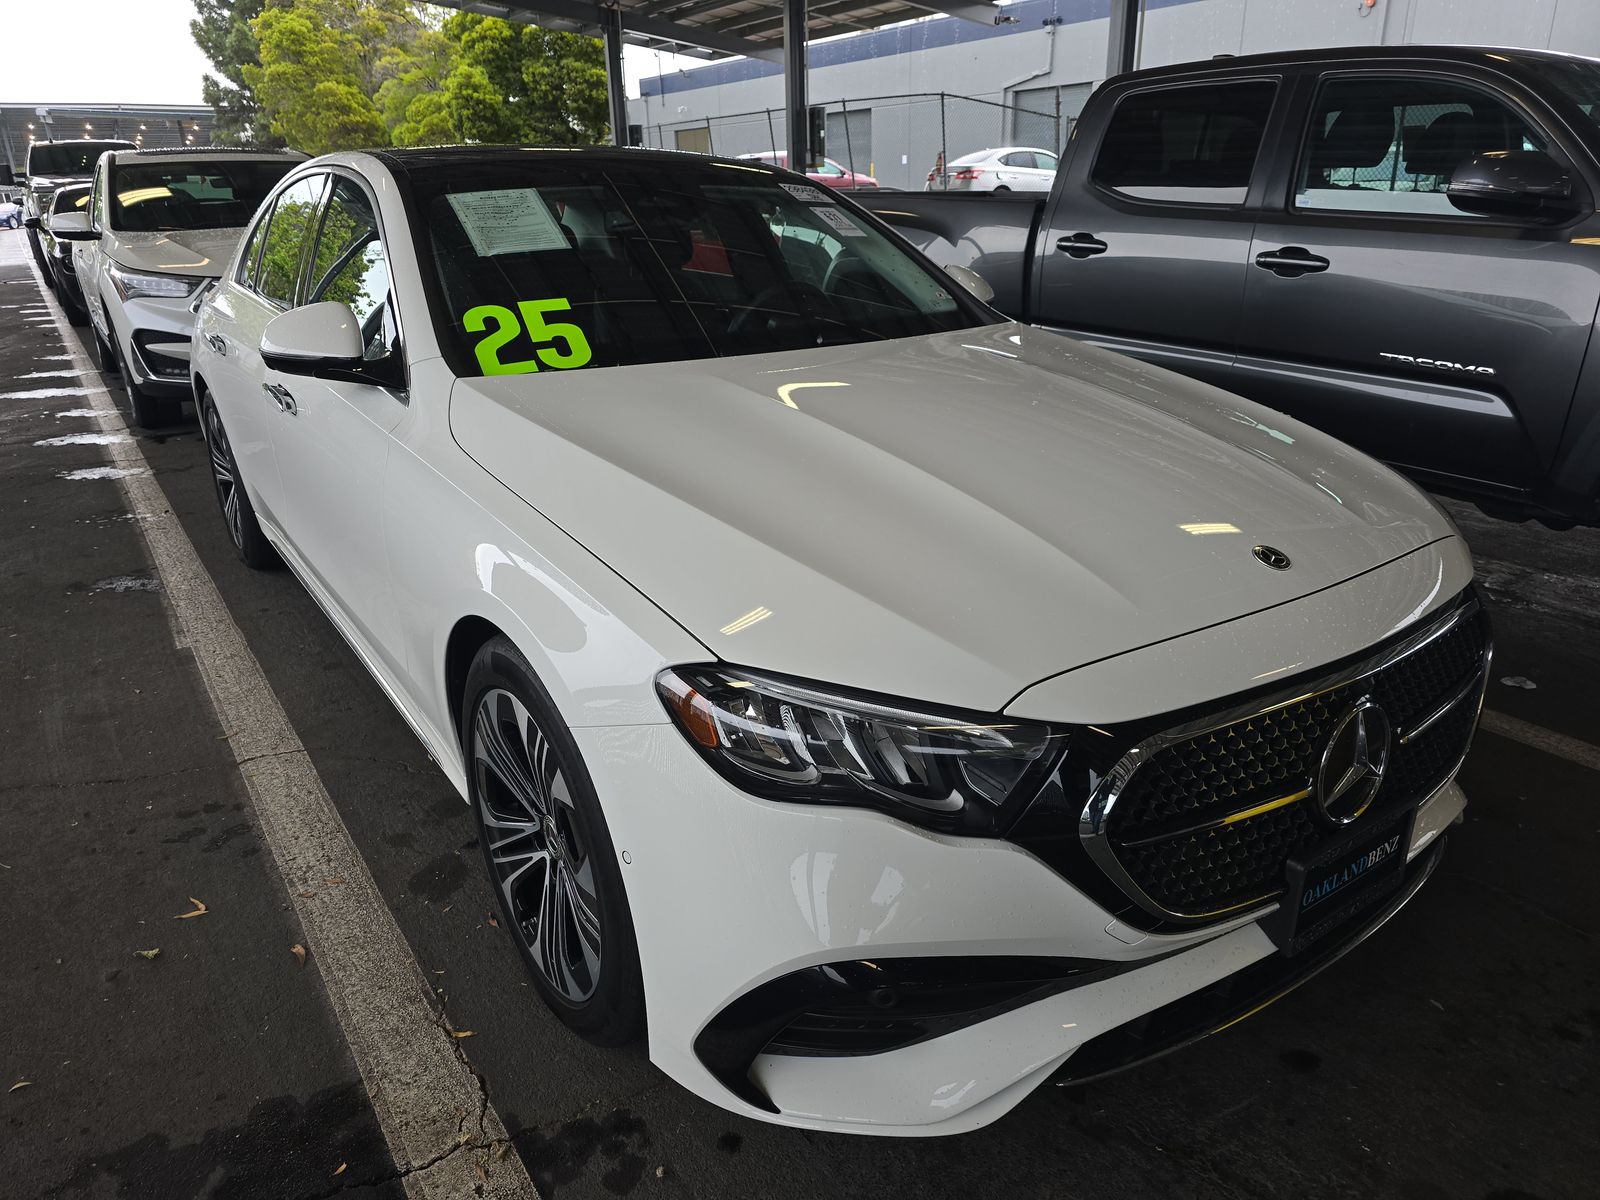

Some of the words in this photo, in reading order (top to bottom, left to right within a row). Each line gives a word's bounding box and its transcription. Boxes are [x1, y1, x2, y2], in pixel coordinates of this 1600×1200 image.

[463, 298, 592, 376] 25
[1379, 352, 1496, 375] TACOMA
[1302, 835, 1400, 907] OAKLANDBENZ
